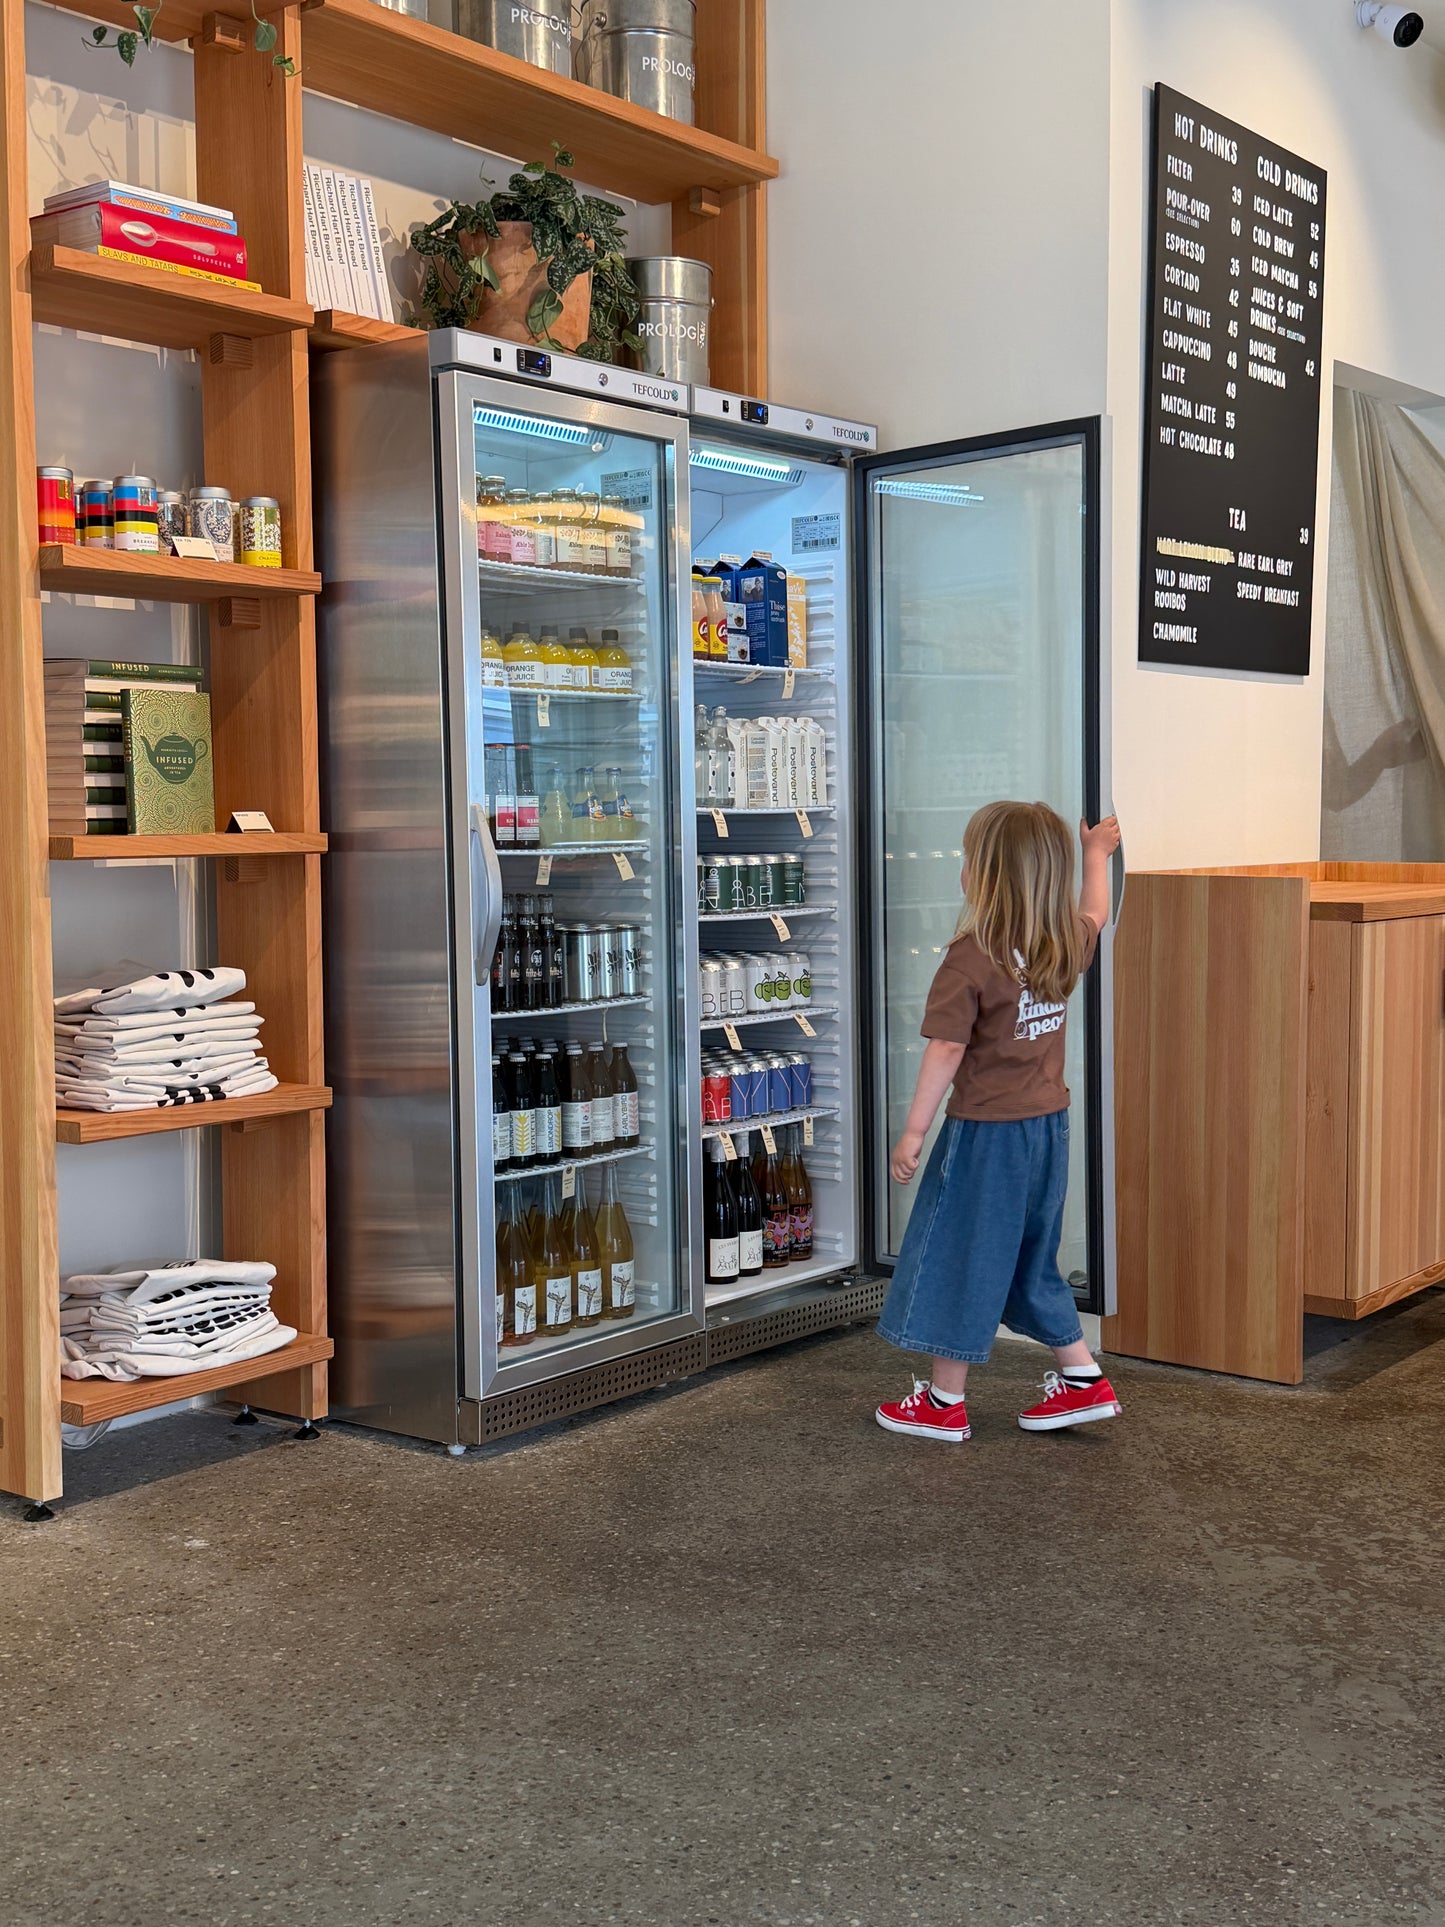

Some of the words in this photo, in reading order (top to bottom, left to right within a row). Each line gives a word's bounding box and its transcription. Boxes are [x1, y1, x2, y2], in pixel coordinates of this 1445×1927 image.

[511, 8, 567, 35] PROLOG
[642, 56, 692, 81] PROLOG
[1174, 113, 1194, 143] HOT
[1200, 125, 1238, 165] DRINKS
[313, 173, 324, 210] Richard
[325, 177, 336, 213] Richard
[1167, 155, 1193, 182] FILTER
[1231, 186, 1241, 206] 39
[1257, 156, 1281, 187] COLD
[1285, 173, 1318, 205] DRINKS
[338, 180, 350, 216] Richard
[349, 184, 360, 220] Richard
[1166, 188, 1211, 222] POUR-OVER
[1231, 217, 1241, 237] 60
[319, 211, 328, 232] Hart
[332, 215, 340, 235] Hart
[344, 217, 353, 238] Hart
[355, 221, 363, 242] Hart
[364, 187, 375, 223] Richard
[370, 224, 378, 244] Hart
[374, 246, 383, 273] Bread
[1253, 195, 1270, 217] ICED
[1272, 205, 1293, 228] LATTE
[1310, 222, 1319, 241] 52
[102, 248, 129, 261] SLAVS
[130, 254, 148, 266] AND
[150, 259, 179, 273] TATARS
[323, 233, 334, 262] Bread
[335, 237, 345, 265] Bread
[348, 240, 358, 267] Bread
[358, 243, 368, 271] Bread
[1165, 232, 1205, 264] ESPRESSO
[1230, 257, 1240, 277] 35
[1252, 226, 1271, 249] COLD
[1274, 235, 1295, 258] BREW
[1309, 250, 1319, 269] 45
[1164, 264, 1200, 293] CORTADO
[1228, 288, 1239, 308] 42
[1251, 255, 1268, 277] ICED
[1271, 264, 1299, 290] MATCHA
[1308, 280, 1317, 299] 55
[1164, 297, 1182, 319] FLAT
[1186, 304, 1211, 329] WHITE
[1228, 320, 1238, 339] 45
[1250, 287, 1276, 311] JUICES
[1287, 300, 1304, 321] SOFT
[638, 322, 697, 340] PROLOG
[1250, 307, 1277, 334] DRINKS
[1162, 330, 1211, 362] CAPPUCCINO
[1227, 351, 1237, 370] 48
[1249, 339, 1277, 364] BOUCHE
[1161, 362, 1185, 385] LATTE
[1226, 381, 1237, 400] 49
[1248, 361, 1286, 390] KOMBUCHA
[1305, 359, 1315, 377] 42
[632, 383, 671, 400] TEFCOLD
[1161, 393, 1192, 419] MATCHA
[1195, 402, 1216, 425] LATTE
[1225, 411, 1236, 430] 55
[832, 427, 863, 441] TEFCOLD
[1160, 426, 1176, 447] HOT
[1179, 430, 1222, 457] CHOCOLATE
[1224, 441, 1235, 460] 48
[1229, 508, 1246, 532] TEA
[1300, 528, 1309, 545] 39
[1155, 568, 1176, 588] WILD
[1179, 572, 1211, 593] HARVEST
[1238, 552, 1256, 570] RARE
[1258, 555, 1275, 573] EARL
[1276, 559, 1293, 577] GREY
[1154, 591, 1186, 612] ROOIBOS
[1237, 581, 1262, 601] SPEEDY
[1265, 587, 1300, 607] BREAKFAST
[1153, 622, 1197, 644] CHAMOMILE
[111, 663, 150, 672] INFUSED
[156, 756, 194, 764] INFUSED
[771, 747, 779, 802] Postevand
[790, 746, 798, 801] Postevand
[810, 746, 818, 800] Postevand
